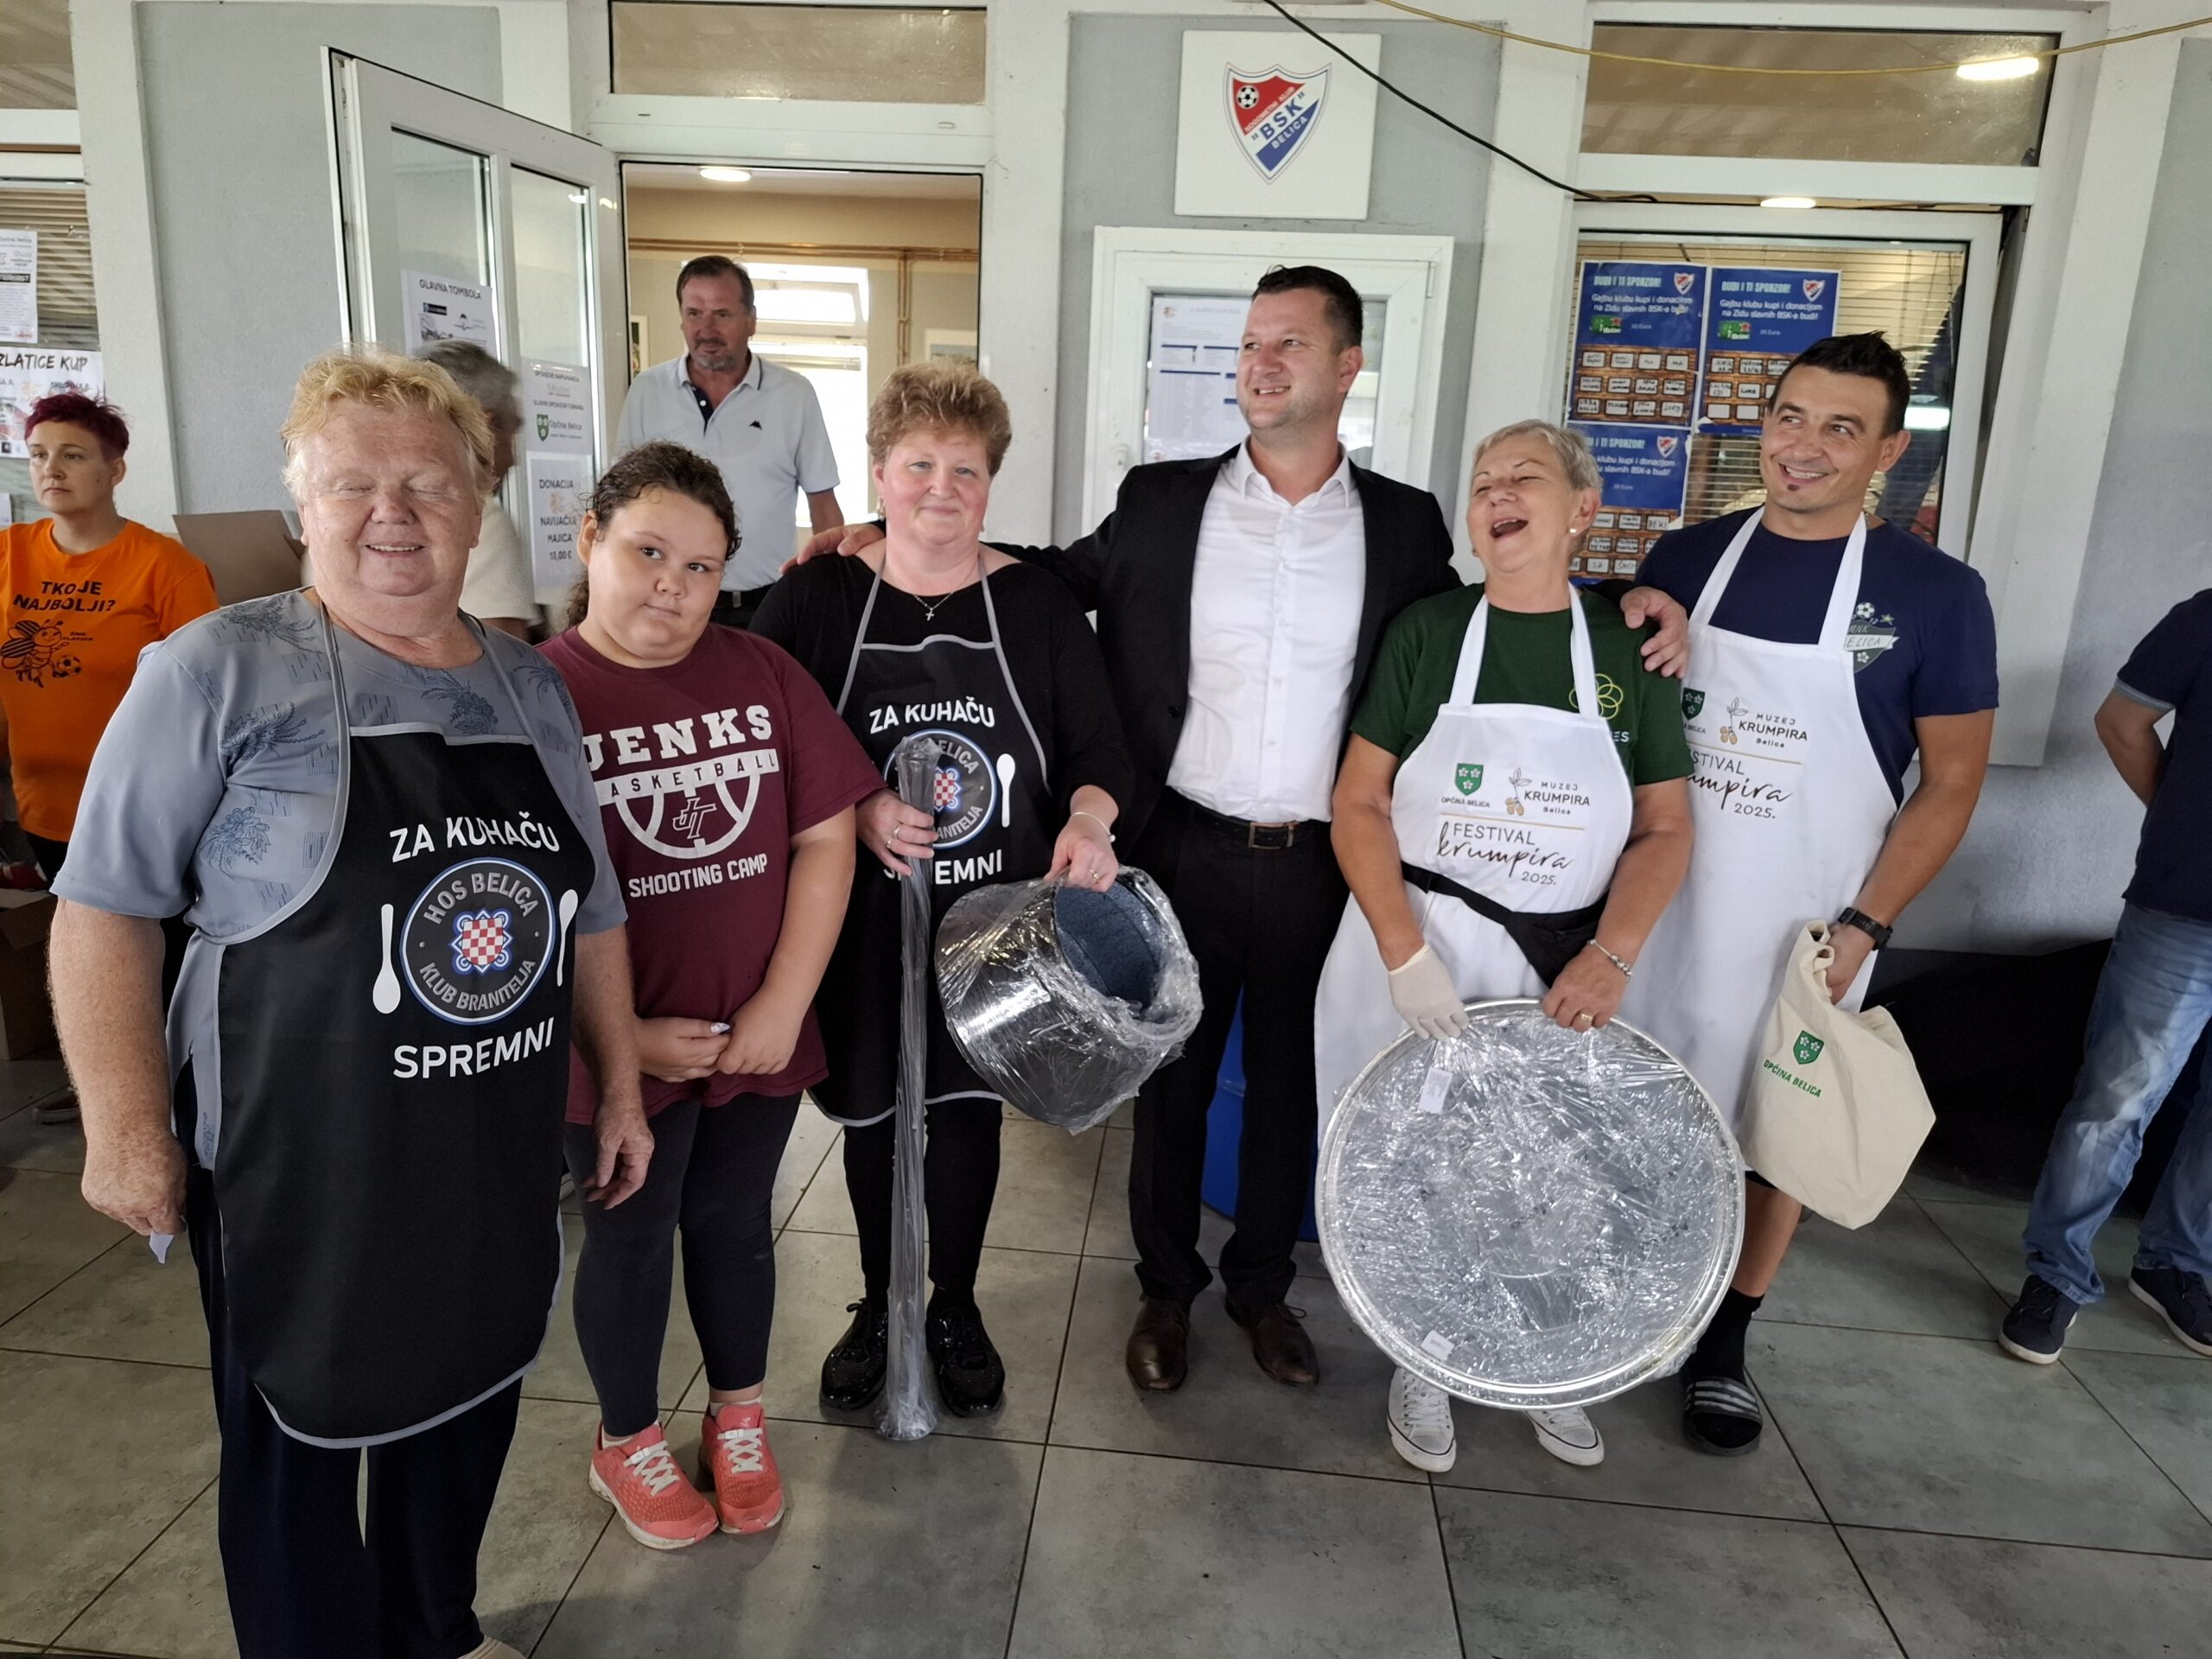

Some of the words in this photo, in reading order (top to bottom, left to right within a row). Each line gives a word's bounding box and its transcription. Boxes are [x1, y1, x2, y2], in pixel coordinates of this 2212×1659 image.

[1271, 116, 1308, 149] BELICA
[419, 278, 448, 292] GLAVNA
[448, 284, 481, 299] TOMBOLA
[60, 355, 88, 372] KUP
[539, 479, 575, 489] DONACIJA
[547, 533, 573, 543] MAJICA
[41, 581, 76, 595] TKO
[78, 581, 102, 594] JE
[13, 594, 116, 612] NAJBOLJI?
[1847, 636, 1881, 648] ELICA
[869, 704, 899, 734] ZA
[905, 696, 995, 728] KUHAČU
[1756, 713, 1796, 726] MUZEJ
[582, 704, 772, 772] JENKS
[1738, 720, 1808, 741] KRUMPIRA
[1757, 738, 1785, 748] Belica
[938, 739, 979, 775] ELICA
[1692, 750, 1745, 776] STIVAL
[610, 754, 775, 798] ASKETBALL
[1541, 781, 1578, 791] MUZEJ
[1466, 799, 1491, 808] BELICA
[1523, 790, 1591, 806] KRUMPIRA
[1542, 805, 1571, 815] Belica
[1734, 803, 1776, 819] 2025.
[937, 804, 983, 839] ANITELJA
[390, 823, 435, 863] ZA
[446, 810, 560, 853] KUHAČU
[1453, 823, 1535, 846] FESTIVAL
[1437, 821, 1574, 878] krumpira
[628, 863, 723, 898] SHOOTING
[728, 853, 767, 880] CAMP
[1521, 871, 1557, 886] 2025.
[423, 880, 467, 925] HOS
[471, 872, 539, 918] BELICA
[419, 962, 456, 1004] KLUB
[456, 958, 537, 1012] BRANITELJA
[393, 1016, 555, 1079] SPREMNI
[1763, 1058, 1793, 1083] OPĆINA
[1792, 1077, 1822, 1098] BELICA
